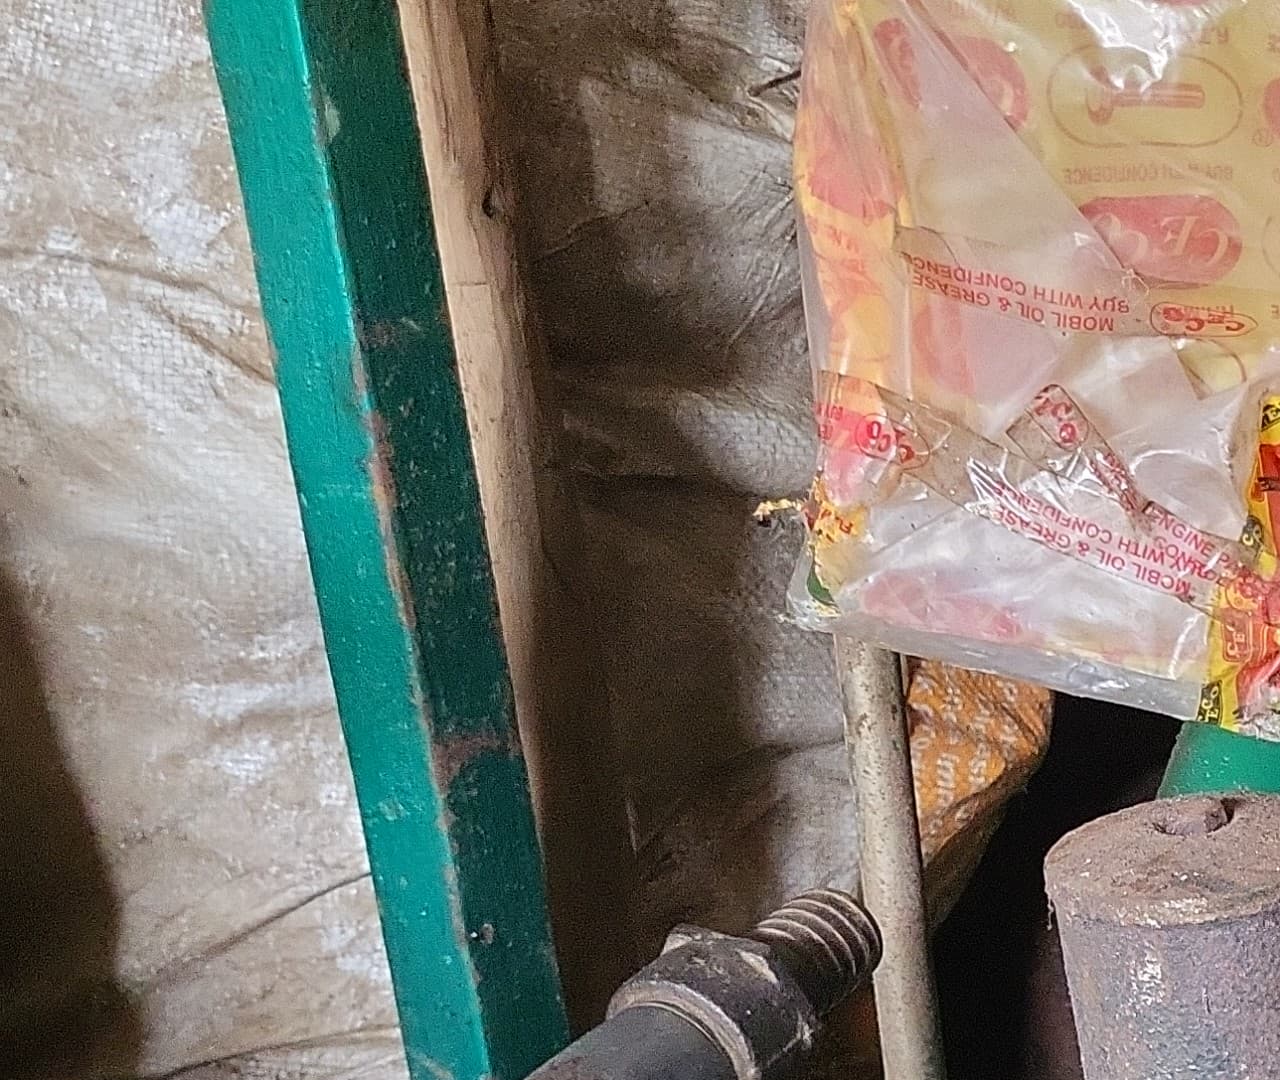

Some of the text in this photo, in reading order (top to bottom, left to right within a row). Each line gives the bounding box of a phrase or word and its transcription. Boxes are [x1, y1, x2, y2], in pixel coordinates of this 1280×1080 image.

[912, 272, 1115, 332] MOBIL OIL & GREASE
[1032, 284, 1083, 310] WITH
[1089, 295, 1130, 313] BUY
[1162, 307, 1245, 332] CECO
[1077, 541, 1091, 558] &
[1095, 547, 1125, 572] OIL
[1118, 536, 1166, 565] WITH
